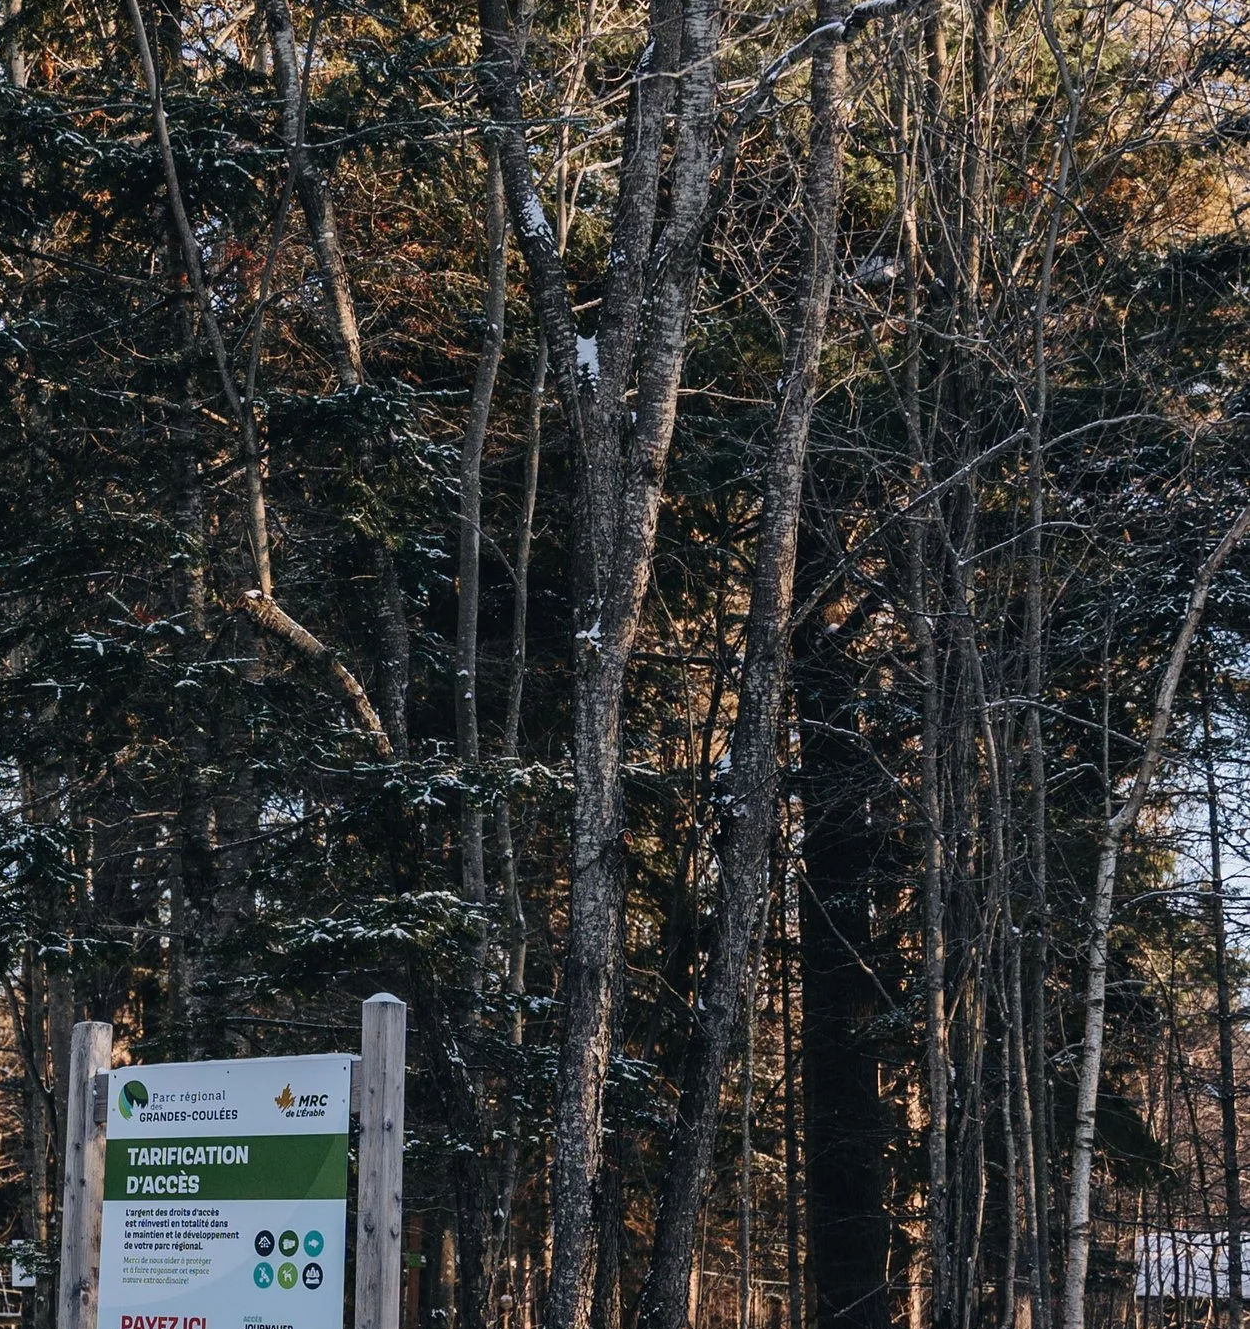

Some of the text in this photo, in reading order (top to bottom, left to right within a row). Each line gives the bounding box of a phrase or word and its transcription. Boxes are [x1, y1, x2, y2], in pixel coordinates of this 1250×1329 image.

[152, 1090, 226, 1104] Parc régional
[298, 1094, 329, 1108] MRC
[139, 1107, 238, 1123] GRANDES-COULÉES
[285, 1107, 326, 1118] de L'Érable
[127, 1145, 249, 1167] TARIFICATION
[126, 1170, 200, 1194] D'ACCÈS
[126, 1208, 220, 1218] L'argent des droits d'accès
[125, 1220, 137, 1228] est
[138, 1219, 170, 1228] réinvesti
[181, 1219, 209, 1228] totalité
[210, 1219, 228, 1228] dans
[124, 1230, 240, 1241] le maintien et le développement
[124, 1242, 133, 1250] de
[154, 1243, 170, 1252] parc
[171, 1242, 203, 1252] régional.
[123, 1256, 140, 1264] Merci
[164, 1256, 180, 1264] aider
[180, 1256, 185, 1264] à
[185, 1257, 212, 1266] protéger
[129, 1266, 134, 1274] à
[134, 1266, 149, 1274] faire
[150, 1267, 178, 1276] rayonner
[189, 1268, 210, 1276] espace
